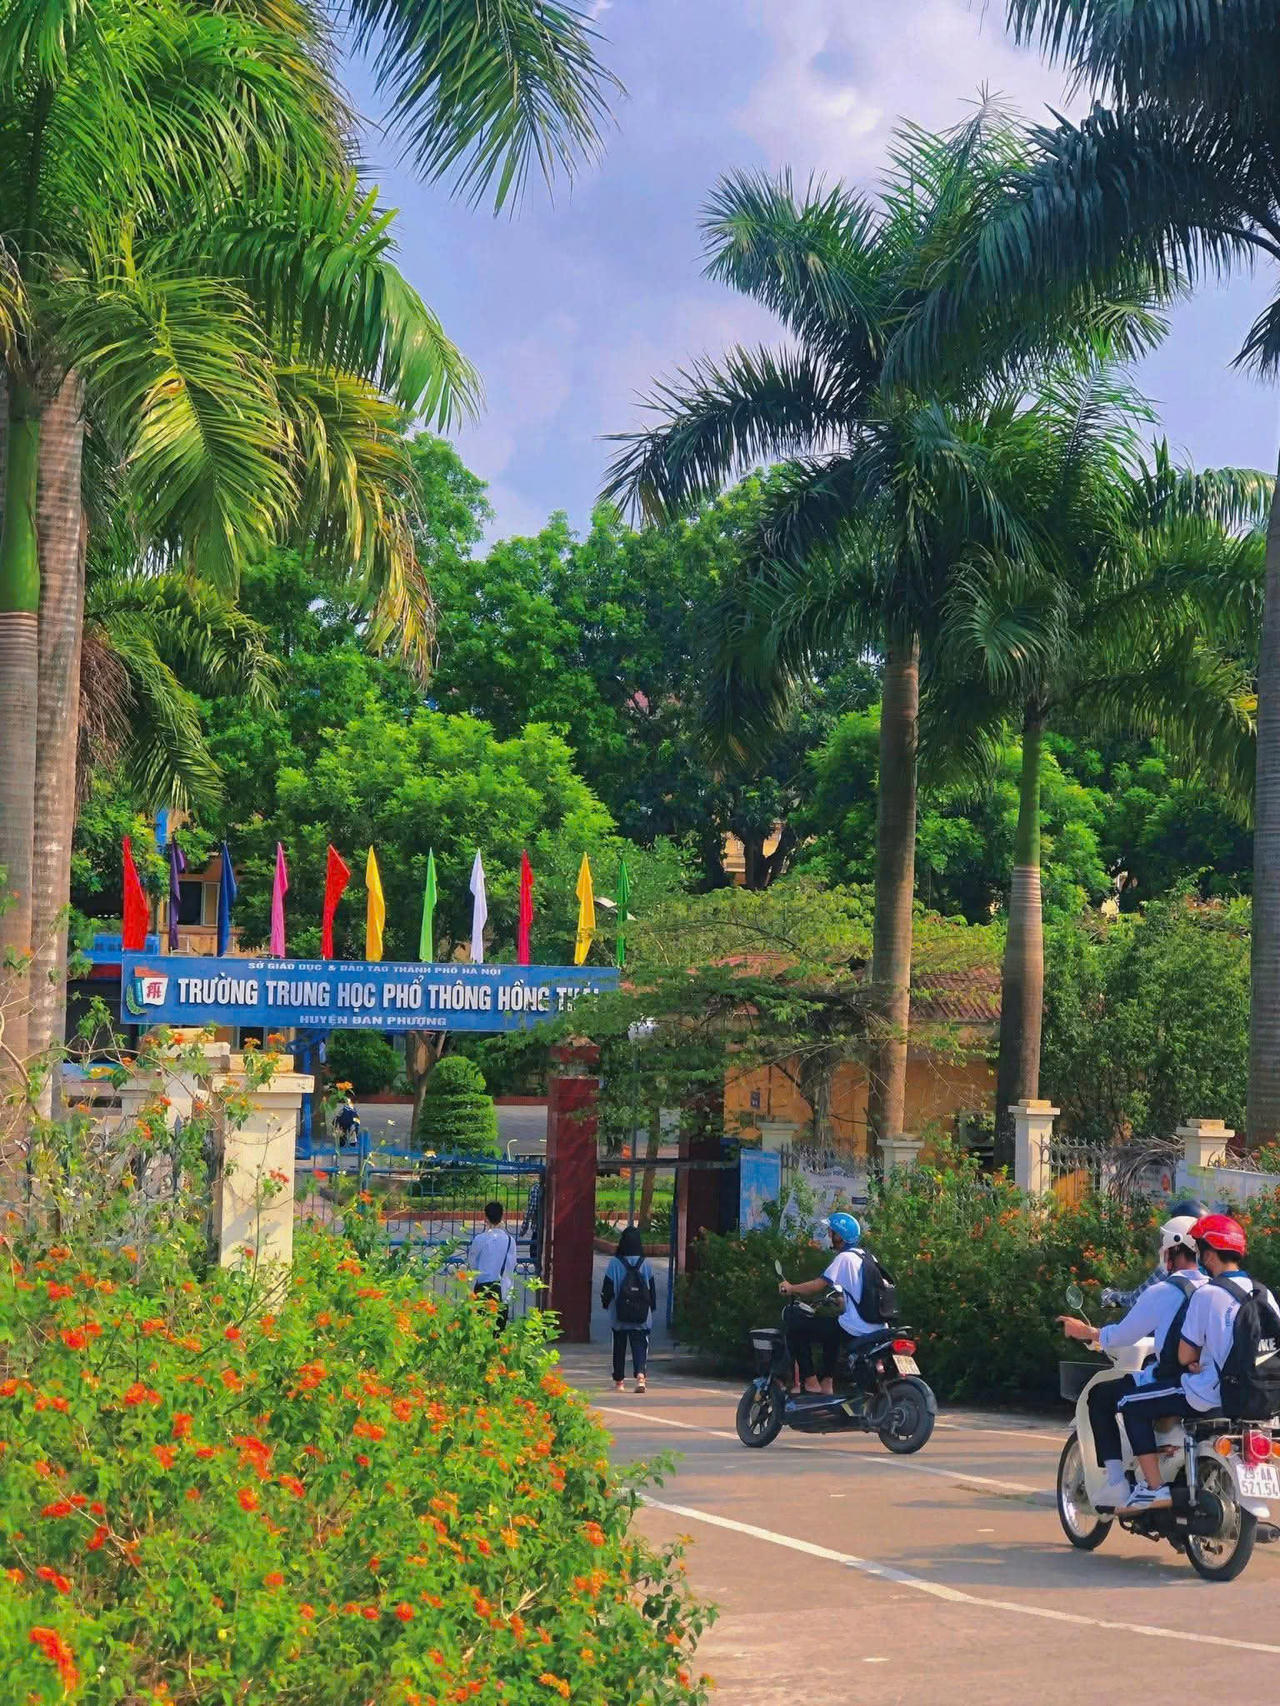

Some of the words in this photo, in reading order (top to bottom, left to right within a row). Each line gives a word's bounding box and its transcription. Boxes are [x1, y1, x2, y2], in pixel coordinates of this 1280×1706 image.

[248, 960, 265, 969] SỞ
[177, 972, 259, 1005] TRƯỜNG
[265, 980, 331, 1007] TRUNG
[337, 982, 377, 1013] HỌC
[383, 975, 424, 1009] PHỔ
[428, 979, 492, 1011] THÔNG
[497, 978, 550, 1012] HỒNG
[300, 1015, 348, 1026] HUYỆN
[387, 1016, 447, 1027] PHƯỢNG
